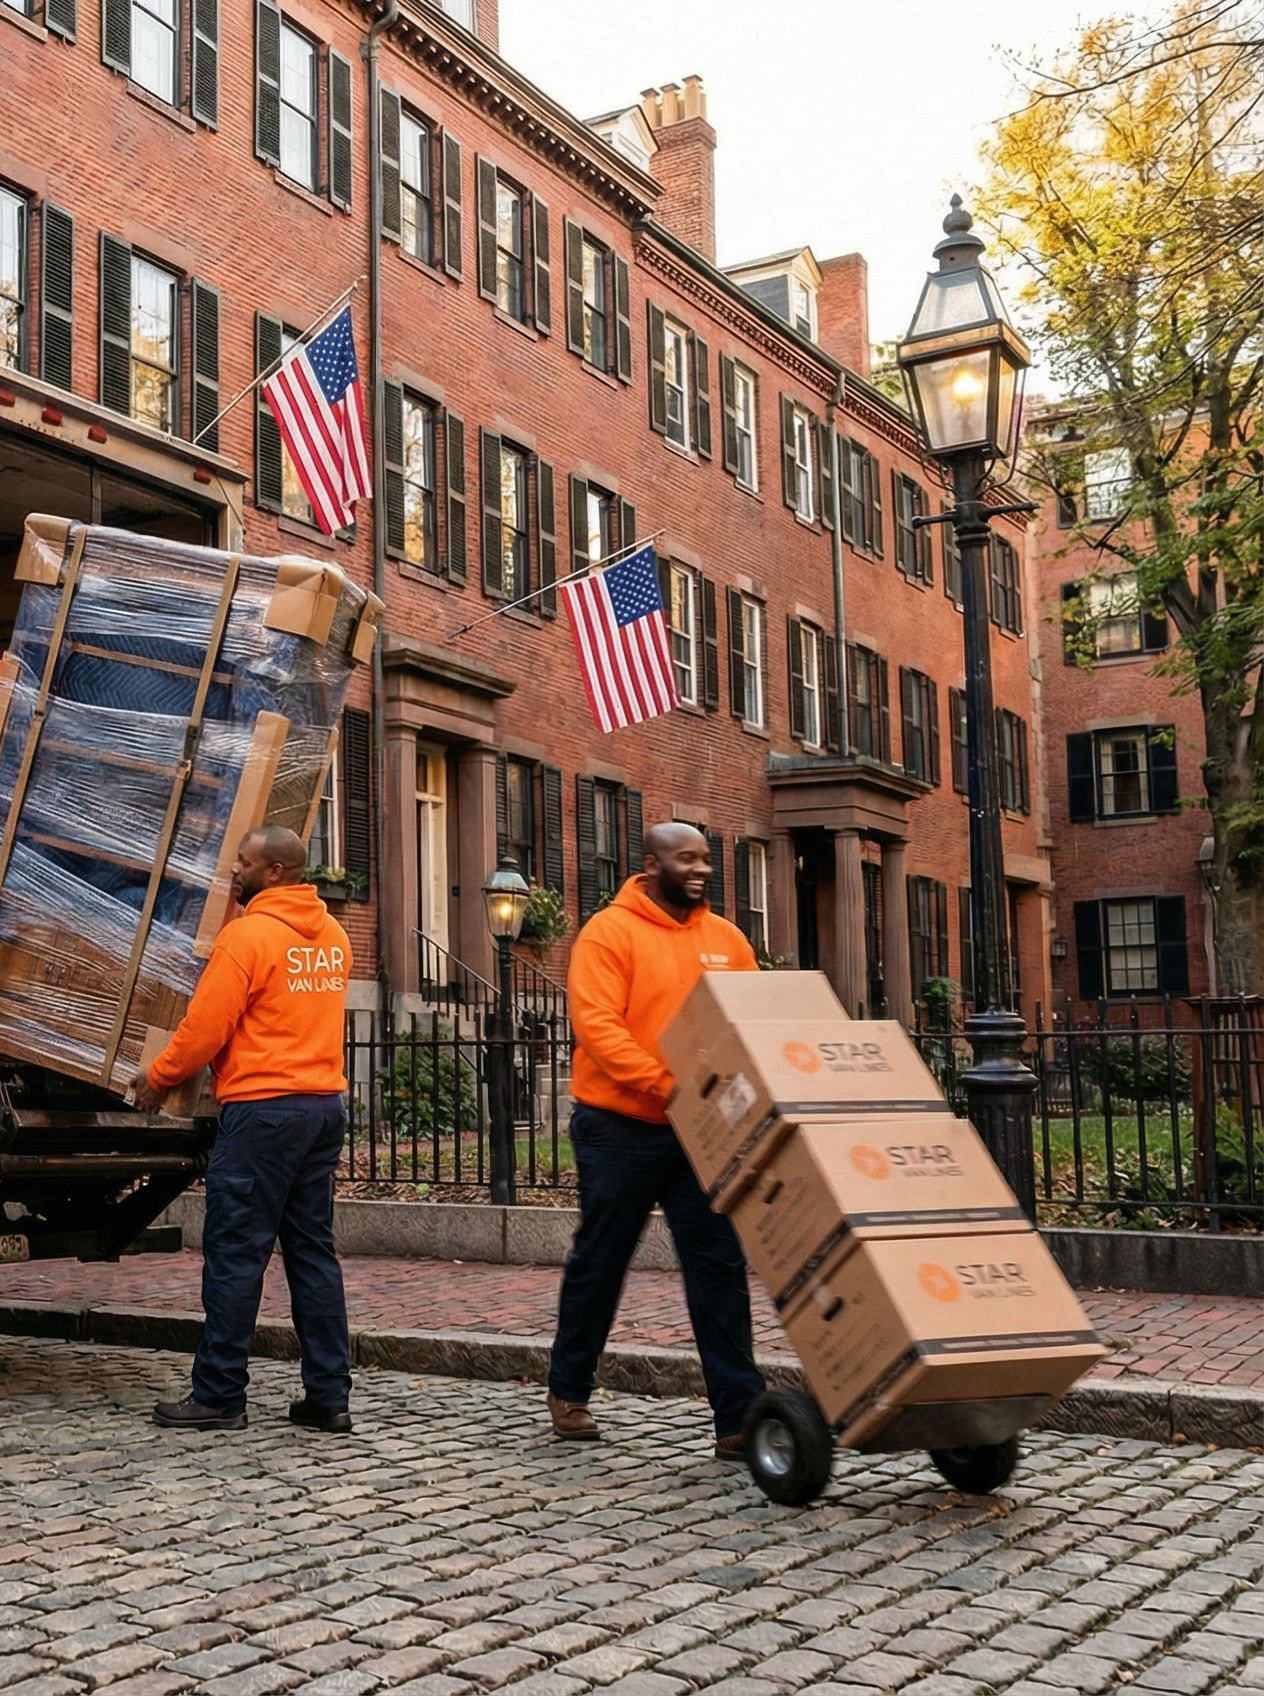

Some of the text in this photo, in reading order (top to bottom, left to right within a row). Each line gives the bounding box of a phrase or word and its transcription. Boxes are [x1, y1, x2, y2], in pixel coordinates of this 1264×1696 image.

[286, 946, 344, 974] STAR
[287, 977, 313, 993] VAN
[817, 1042, 887, 1062] STAR
[886, 1144, 957, 1166] STAR
[954, 1262, 1029, 1286] STAR
